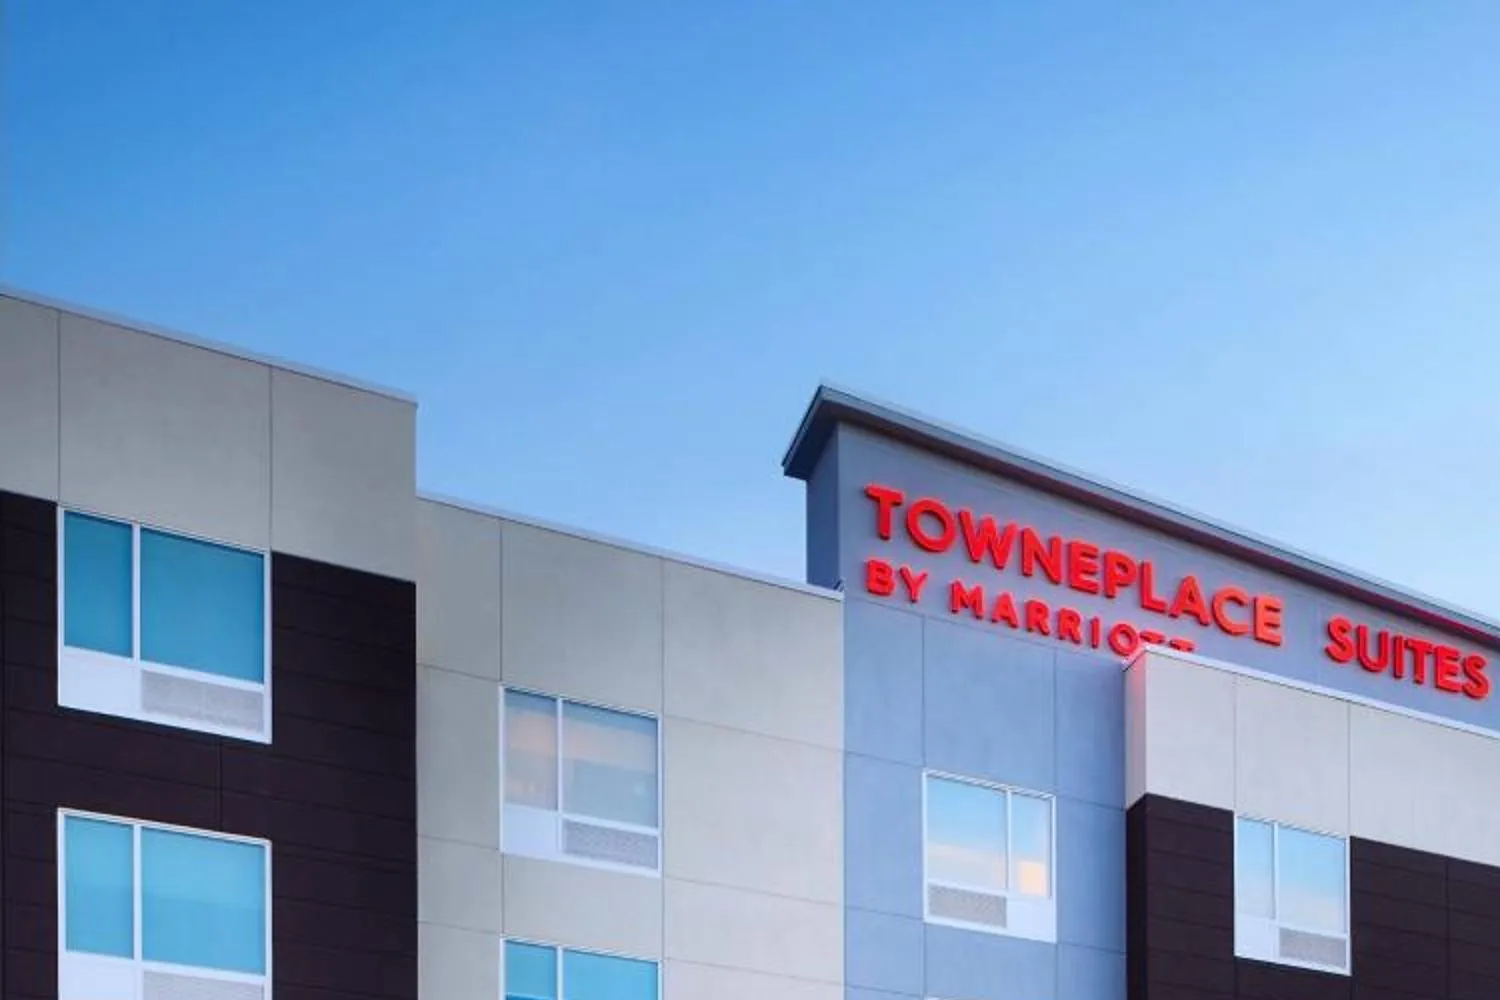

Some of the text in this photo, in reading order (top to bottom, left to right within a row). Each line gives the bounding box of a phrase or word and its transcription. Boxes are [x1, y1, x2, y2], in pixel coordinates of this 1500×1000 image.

[864, 557, 929, 603] BY
[865, 482, 1491, 700] TOWNEPLACE SUITES
